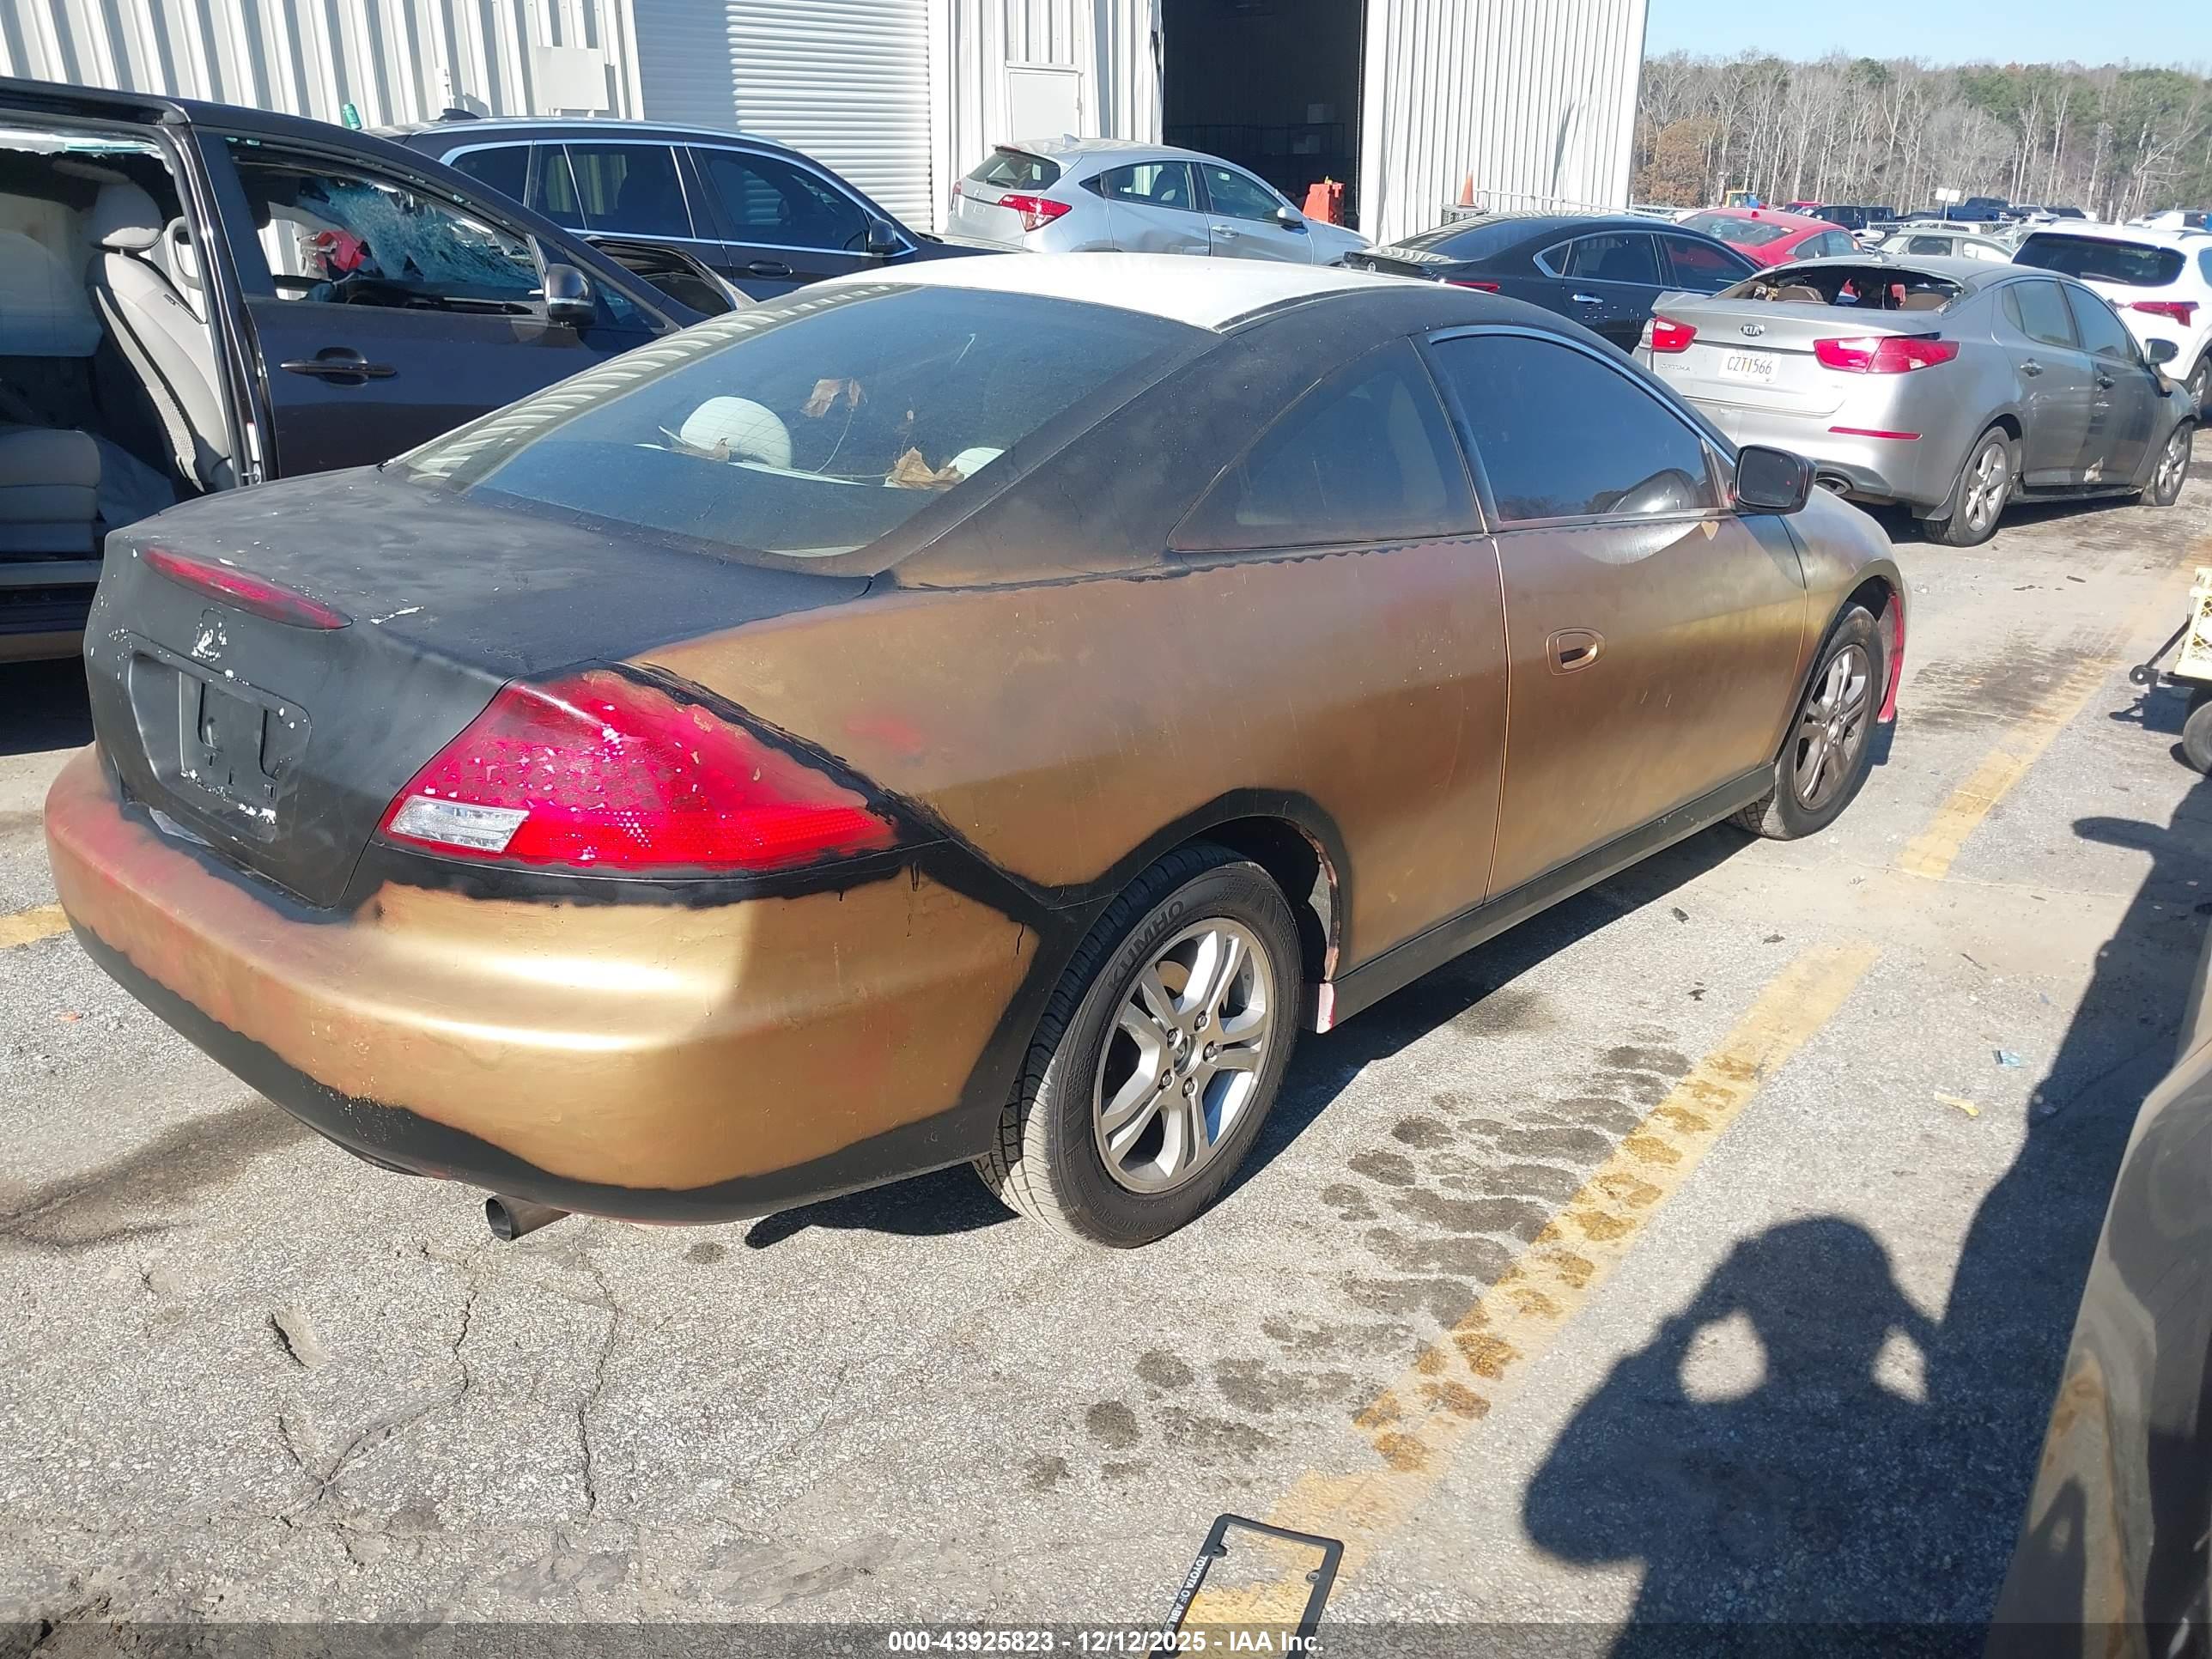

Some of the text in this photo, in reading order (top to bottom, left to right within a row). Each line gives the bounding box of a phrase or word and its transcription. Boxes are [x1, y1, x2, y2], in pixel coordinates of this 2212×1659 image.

[1742, 325, 1760, 336] KIA
[1727, 356, 1773, 375] CZT1566
[1107, 901, 1184, 990] KUMHO
[1183, 1554, 1209, 1589] TOYOTA
[1178, 1590, 1191, 1603] OF
